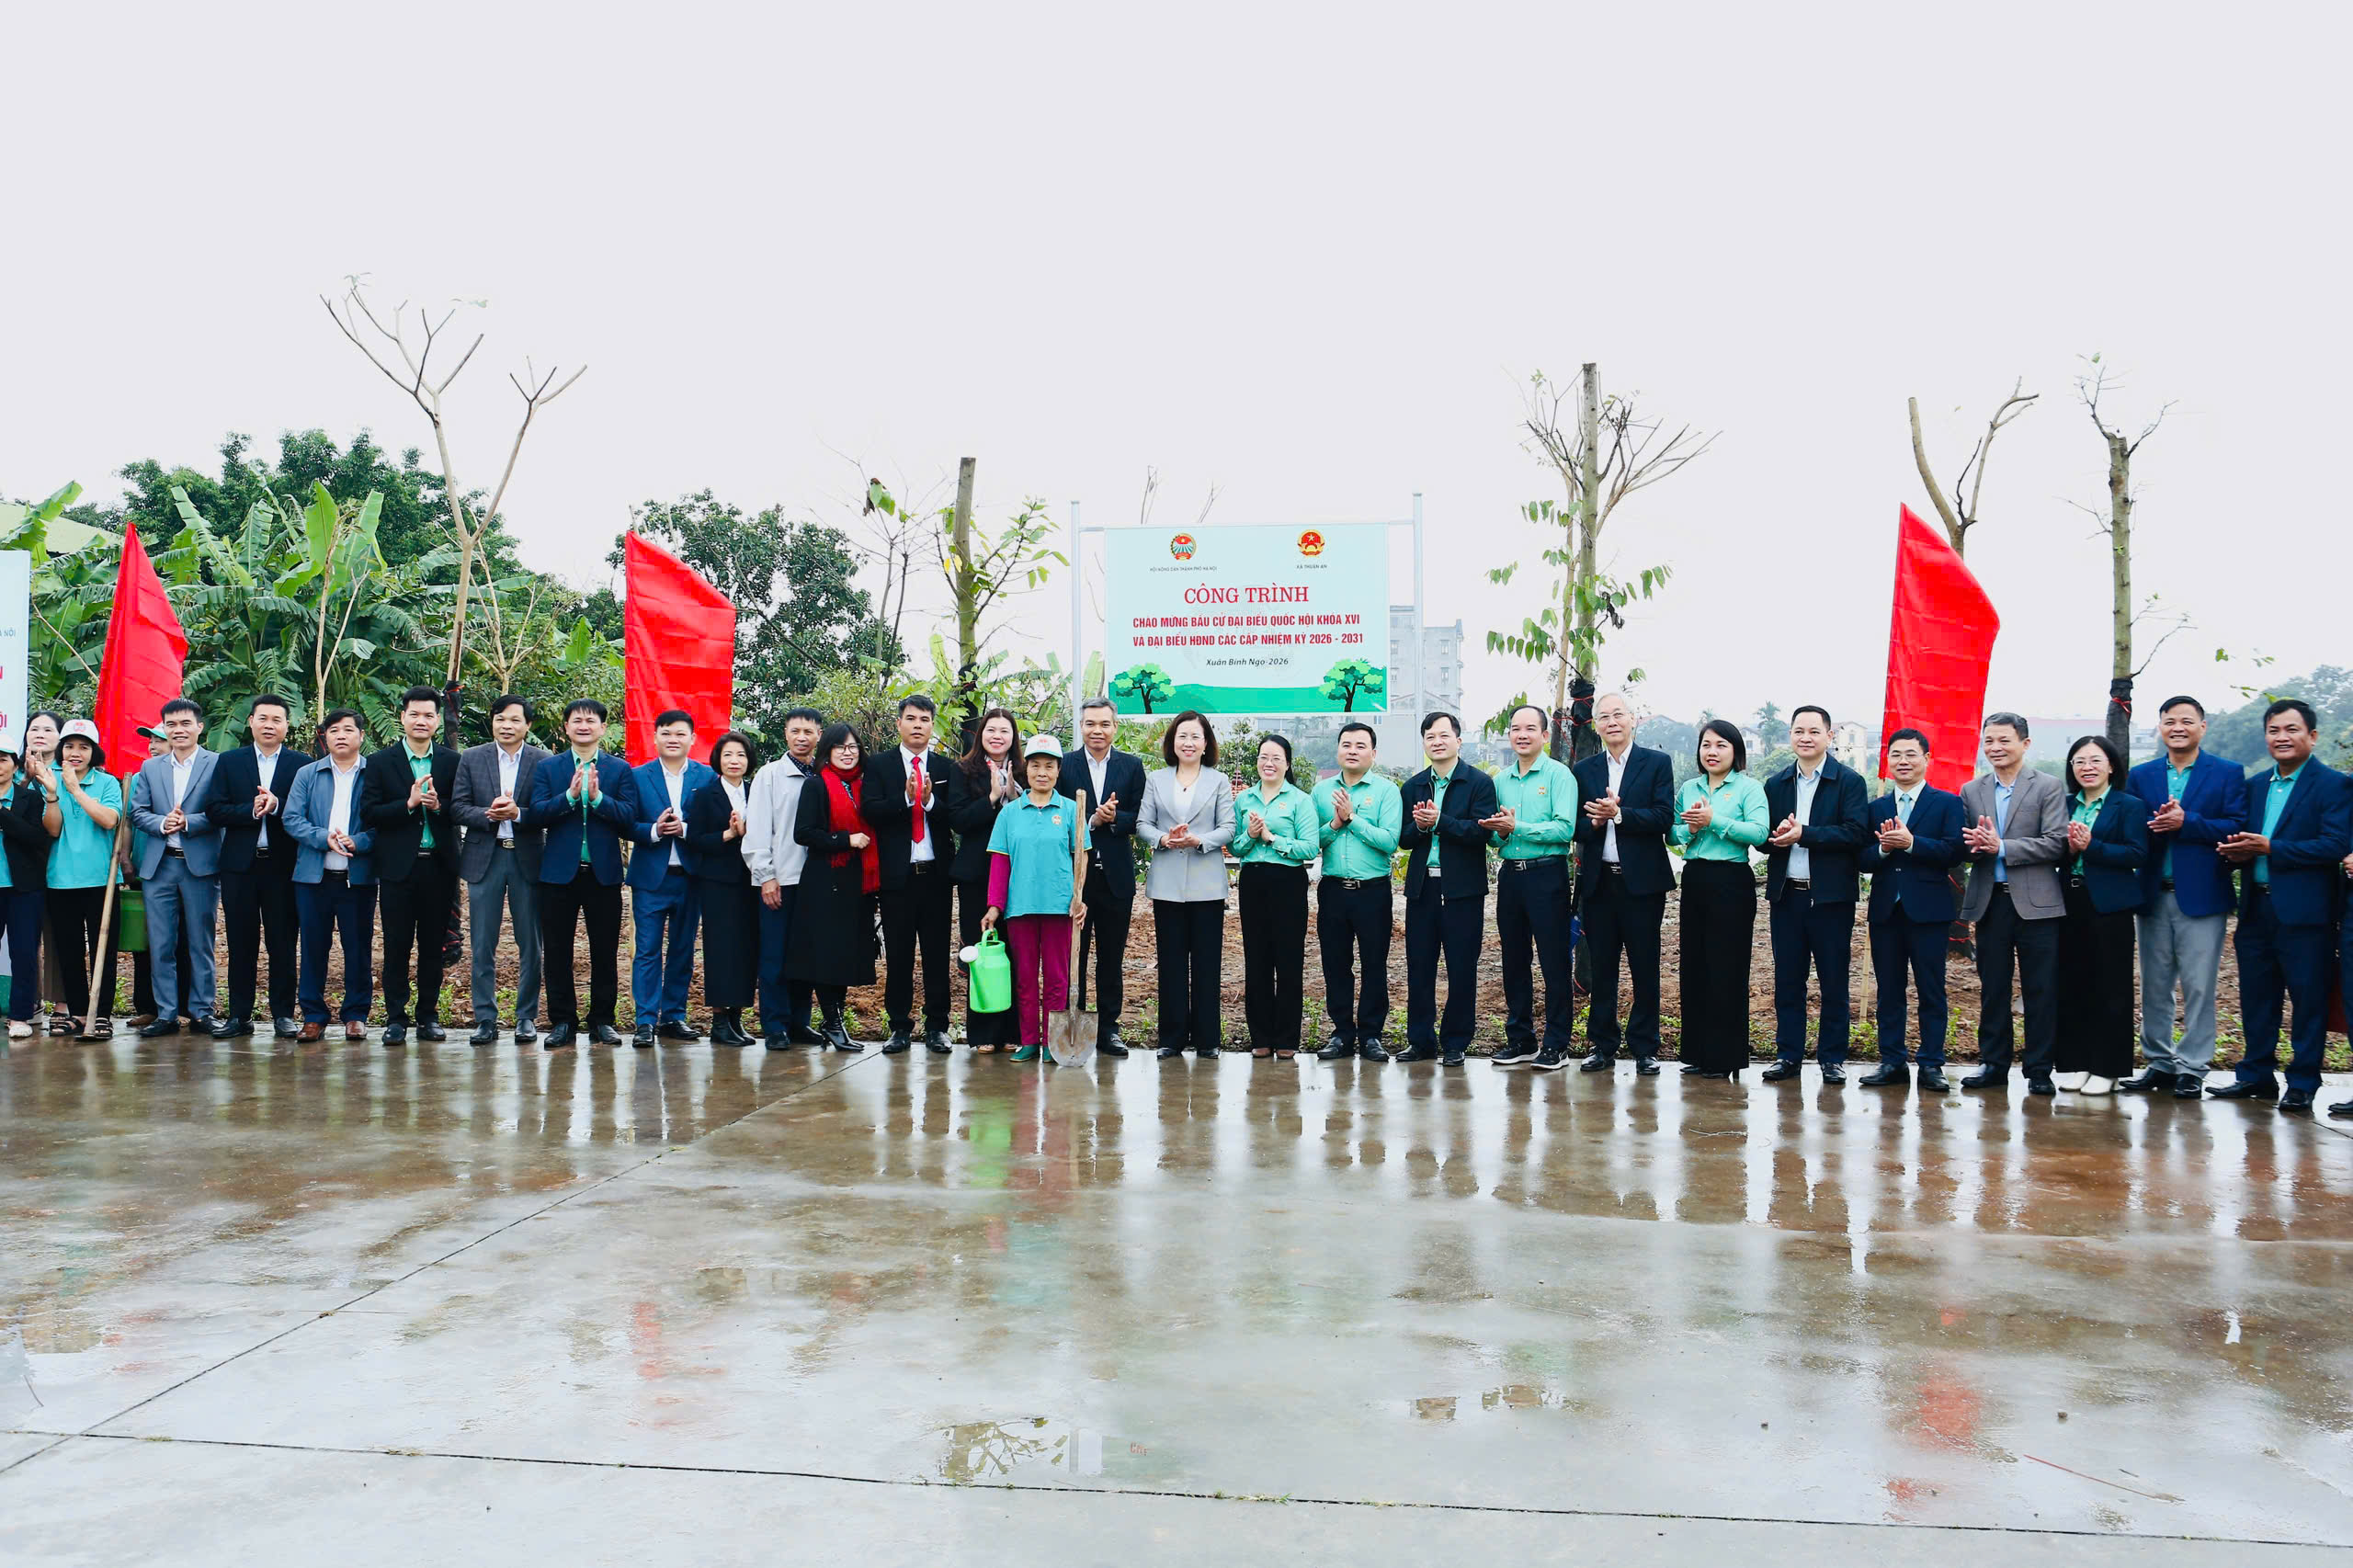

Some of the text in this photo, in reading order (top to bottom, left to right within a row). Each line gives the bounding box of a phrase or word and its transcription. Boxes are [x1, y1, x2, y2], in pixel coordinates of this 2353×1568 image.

[1184, 582, 1309, 604] CÔNG TRÌNH
[1132, 615, 1158, 628] CHÀO
[1160, 614, 1188, 628] MỪNG
[1212, 612, 1226, 627] CỬ
[1227, 616, 1244, 629] ĐẠI
[1245, 611, 1267, 626] BIỂU
[1270, 611, 1296, 627] QUỐC
[1298, 612, 1314, 628] HỘI
[1316, 612, 1342, 625] KHÓA
[1345, 614, 1360, 625] XVI
[4, 627, 16, 637] NỘI
[1132, 634, 1145, 647] VÀ
[1147, 635, 1163, 649] ĐẠI
[1165, 631, 1188, 646] BIỂU
[1189, 635, 1215, 646] HĐND
[1218, 633, 1237, 646] CÁC
[1239, 632, 1258, 645] CẤP
[1260, 632, 1292, 647] NHIỆM
[1294, 631, 1307, 645] KỲ
[1309, 633, 1332, 644] 2026
[1341, 632, 1363, 644] 2031
[1206, 658, 1227, 666] Xuân
